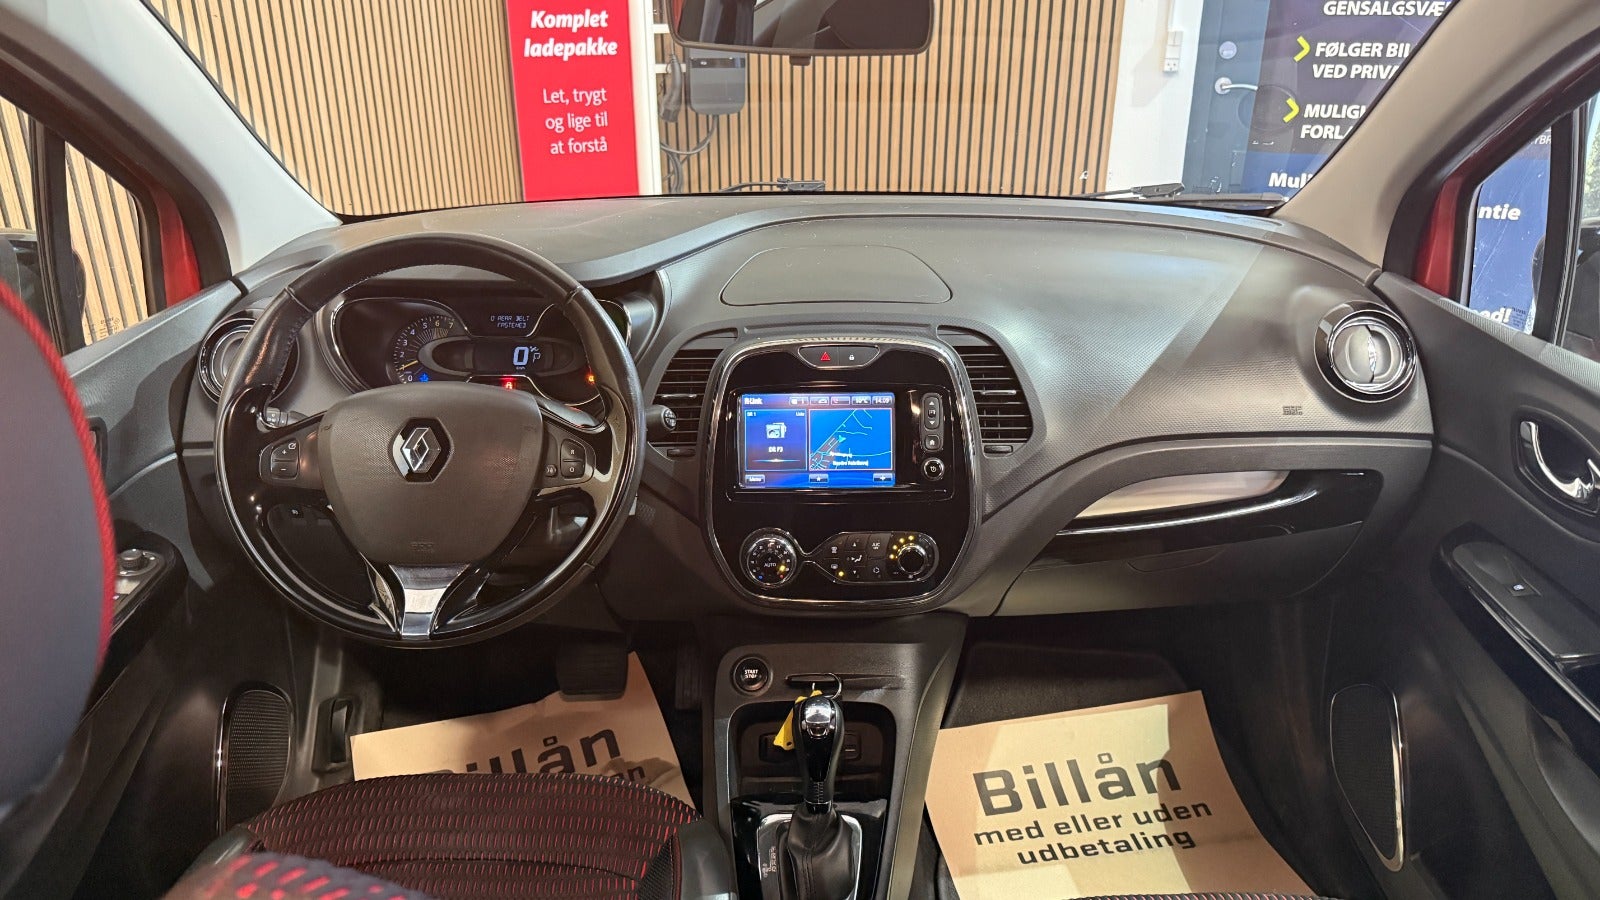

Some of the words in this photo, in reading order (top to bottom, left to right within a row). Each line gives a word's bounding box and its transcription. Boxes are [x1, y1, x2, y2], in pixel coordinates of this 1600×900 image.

[530, 9, 608, 33] Komplet
[524, 37, 618, 61] ladepakke
[1315, 42, 1383, 57] FØLGER
[1312, 64, 1347, 78] VED
[543, 88, 569, 105] Let,
[573, 88, 607, 106] trygt
[545, 118, 565, 133] og
[567, 113, 591, 134] lige
[595, 112, 608, 127] til
[550, 141, 564, 154] at
[567, 136, 608, 153] forstå
[1478, 203, 1521, 221] ntie
[513, 346, 530, 366] 0
[972, 752, 1181, 816] Billån
[973, 820, 1044, 845] med
[1053, 812, 1123, 835] eller
[1132, 801, 1212, 826] uden
[1017, 830, 1197, 865] udbetaling
